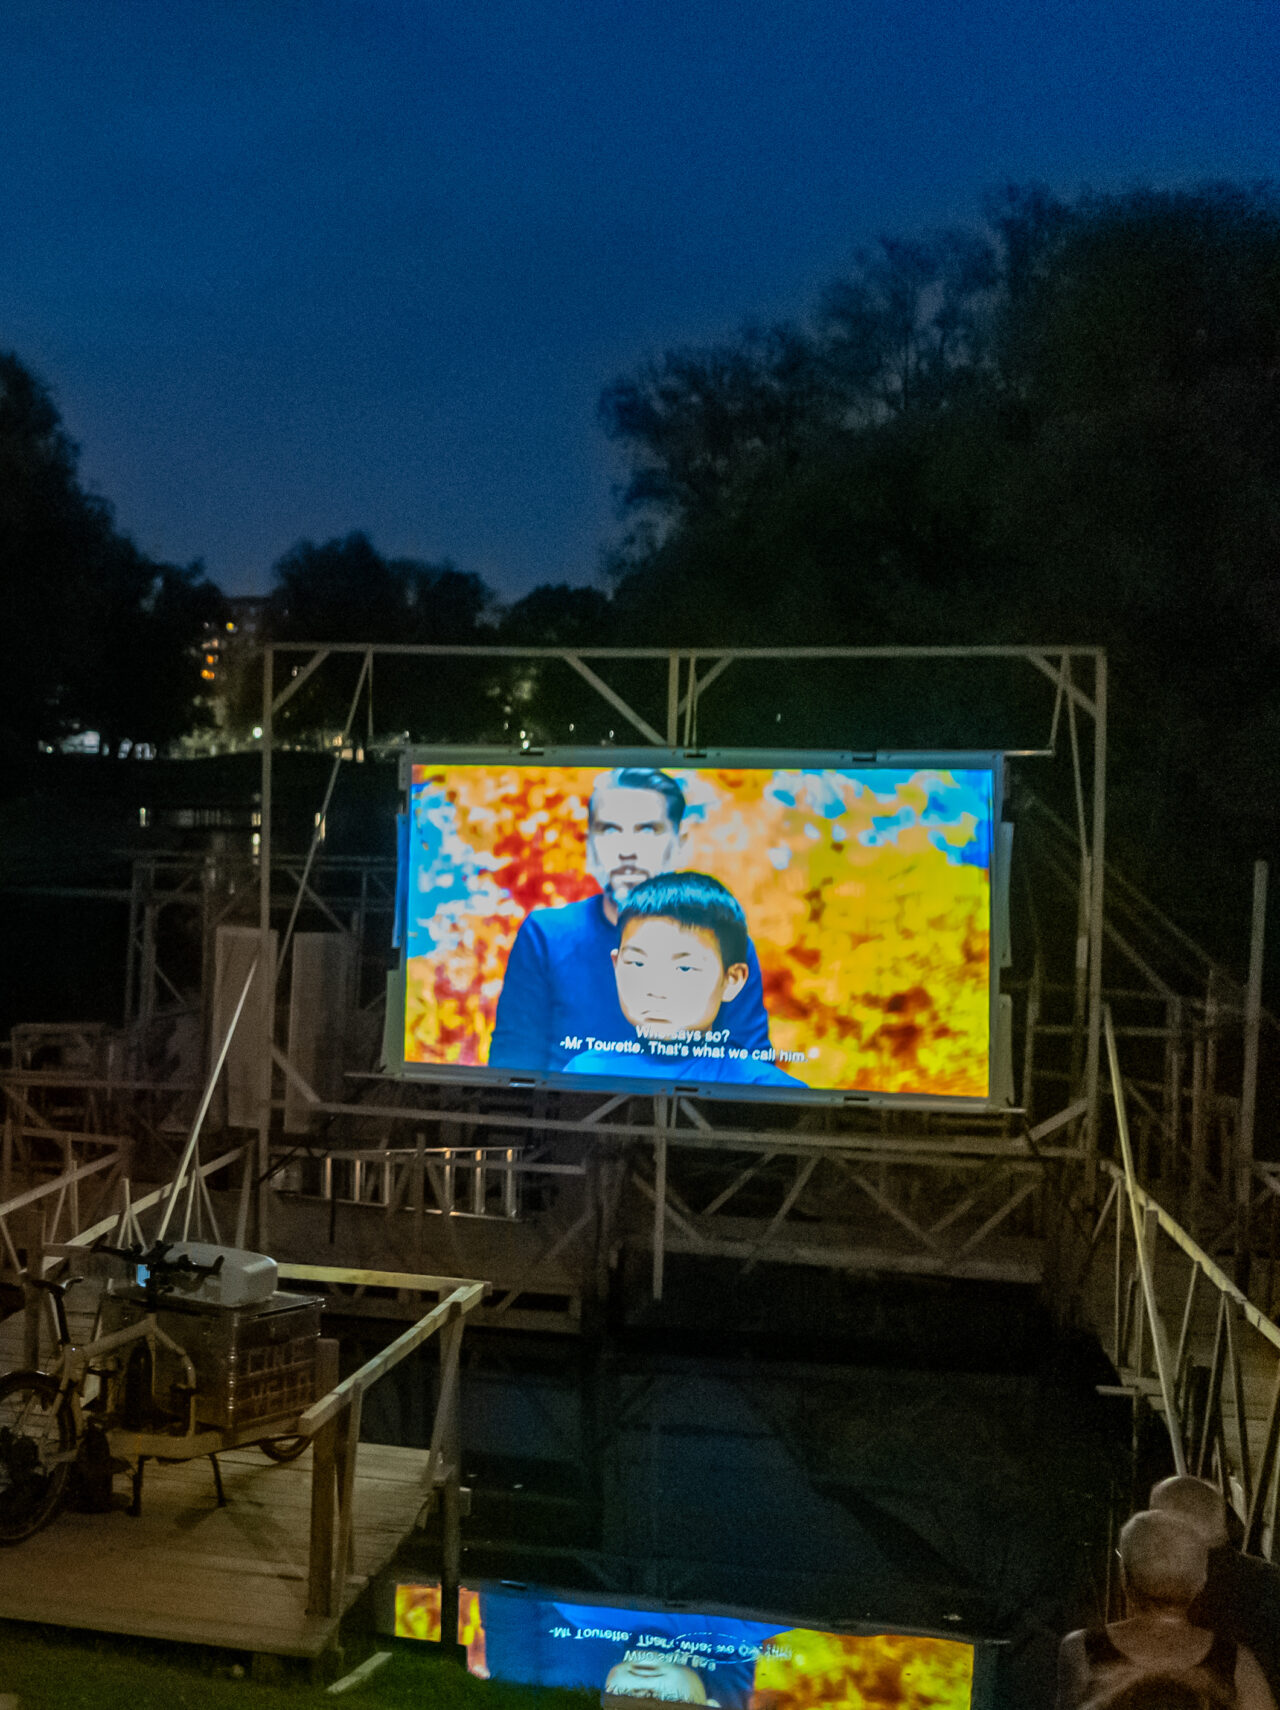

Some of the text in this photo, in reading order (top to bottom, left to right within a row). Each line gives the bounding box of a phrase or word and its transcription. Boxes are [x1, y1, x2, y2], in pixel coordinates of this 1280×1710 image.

[670, 1028, 702, 1043] says
[704, 1029, 731, 1043] so?
[560, 1036, 583, 1050] -Mr
[648, 1041, 689, 1056] That's
[692, 1044, 725, 1059] what
[729, 1048, 749, 1059] we
[751, 1048, 776, 1061] call
